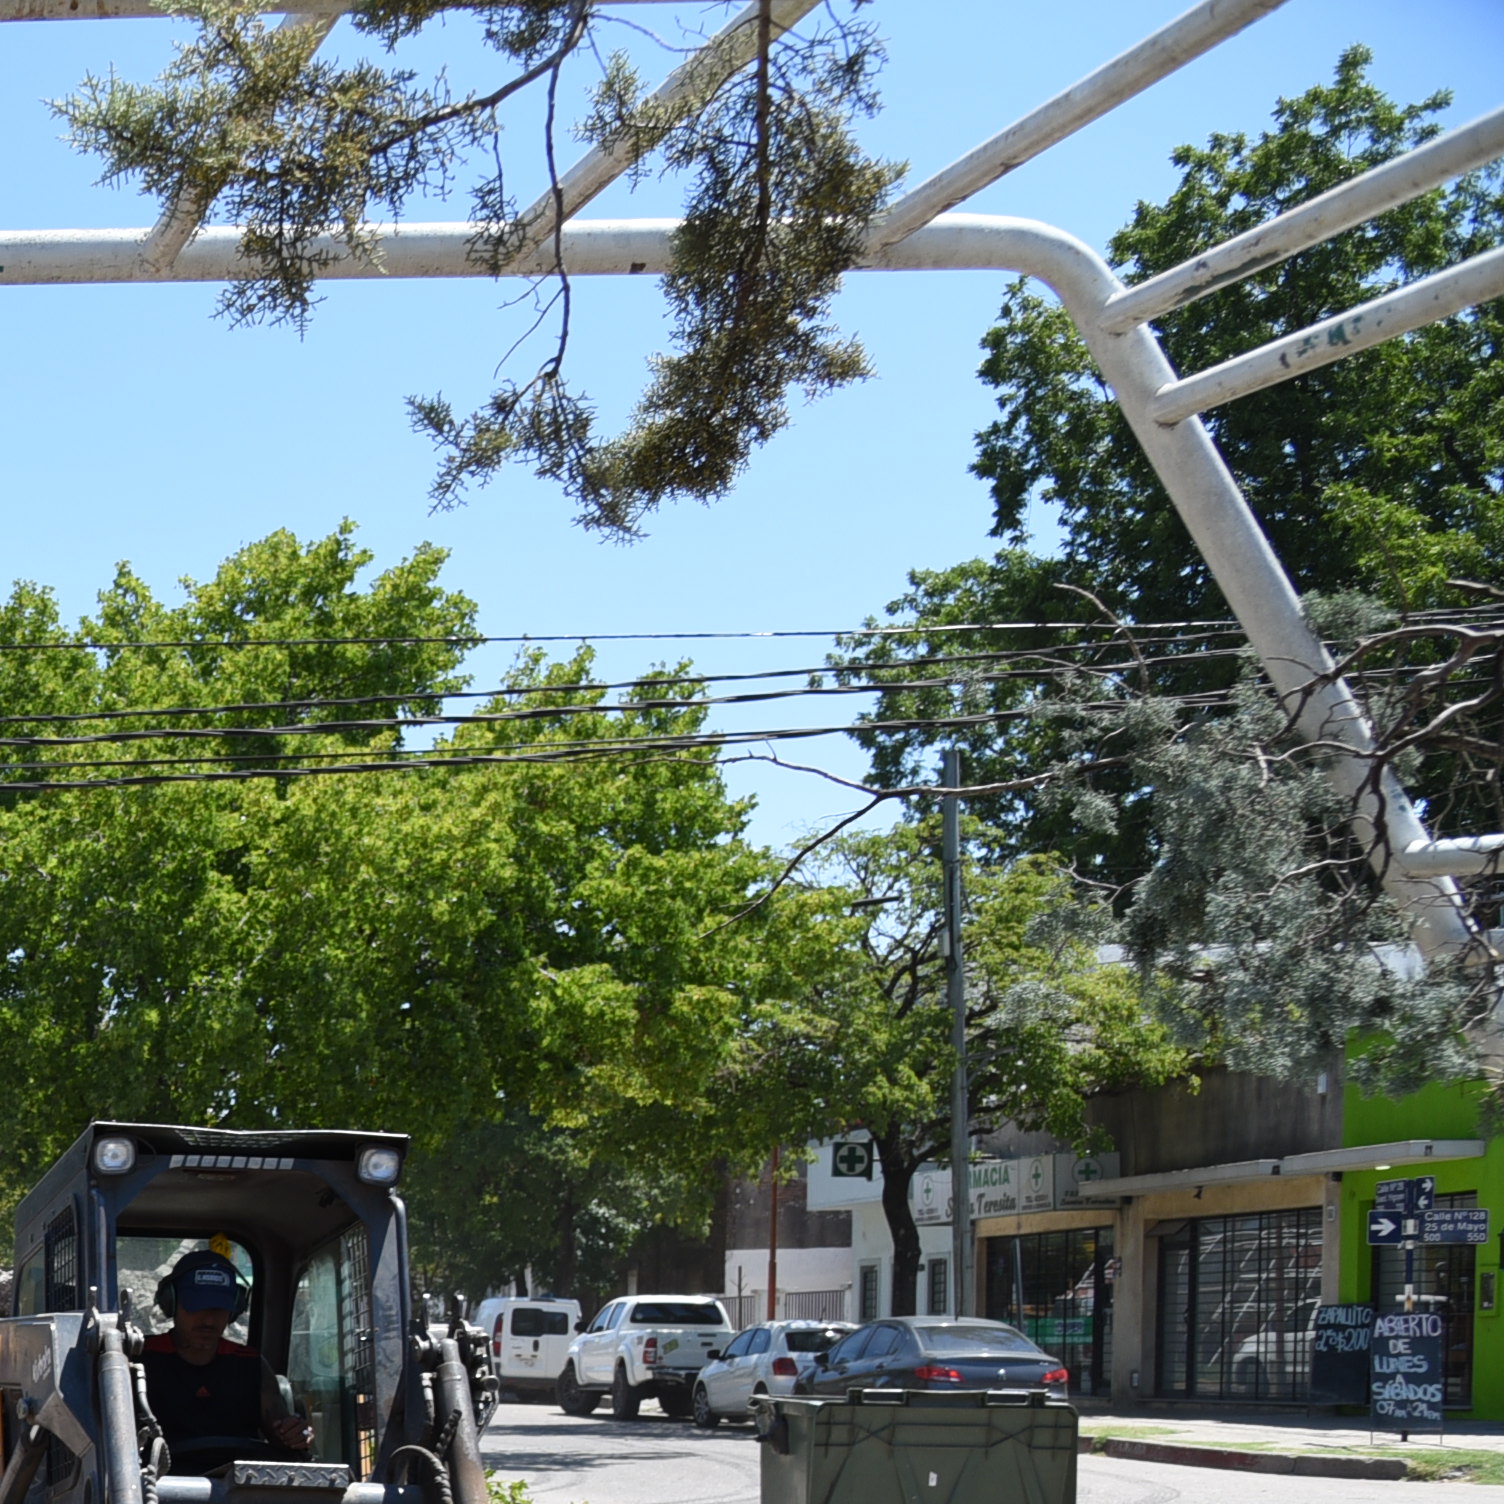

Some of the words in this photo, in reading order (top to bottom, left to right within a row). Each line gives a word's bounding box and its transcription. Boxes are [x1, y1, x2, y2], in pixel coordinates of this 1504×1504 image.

[976, 1191, 1017, 1215] Teresita
[1424, 1212, 1452, 1221] Calle
[1424, 1223, 1438, 1232] 25
[1440, 1223, 1454, 1231] de
[1456, 1223, 1486, 1234] Mayo
[1423, 1233, 1441, 1242] 500
[1466, 1233, 1486, 1242] 550
[1372, 1314, 1442, 1338] ABIERTO
[1388, 1338, 1412, 1354] DE
[1373, 1354, 1429, 1374] LUNES
